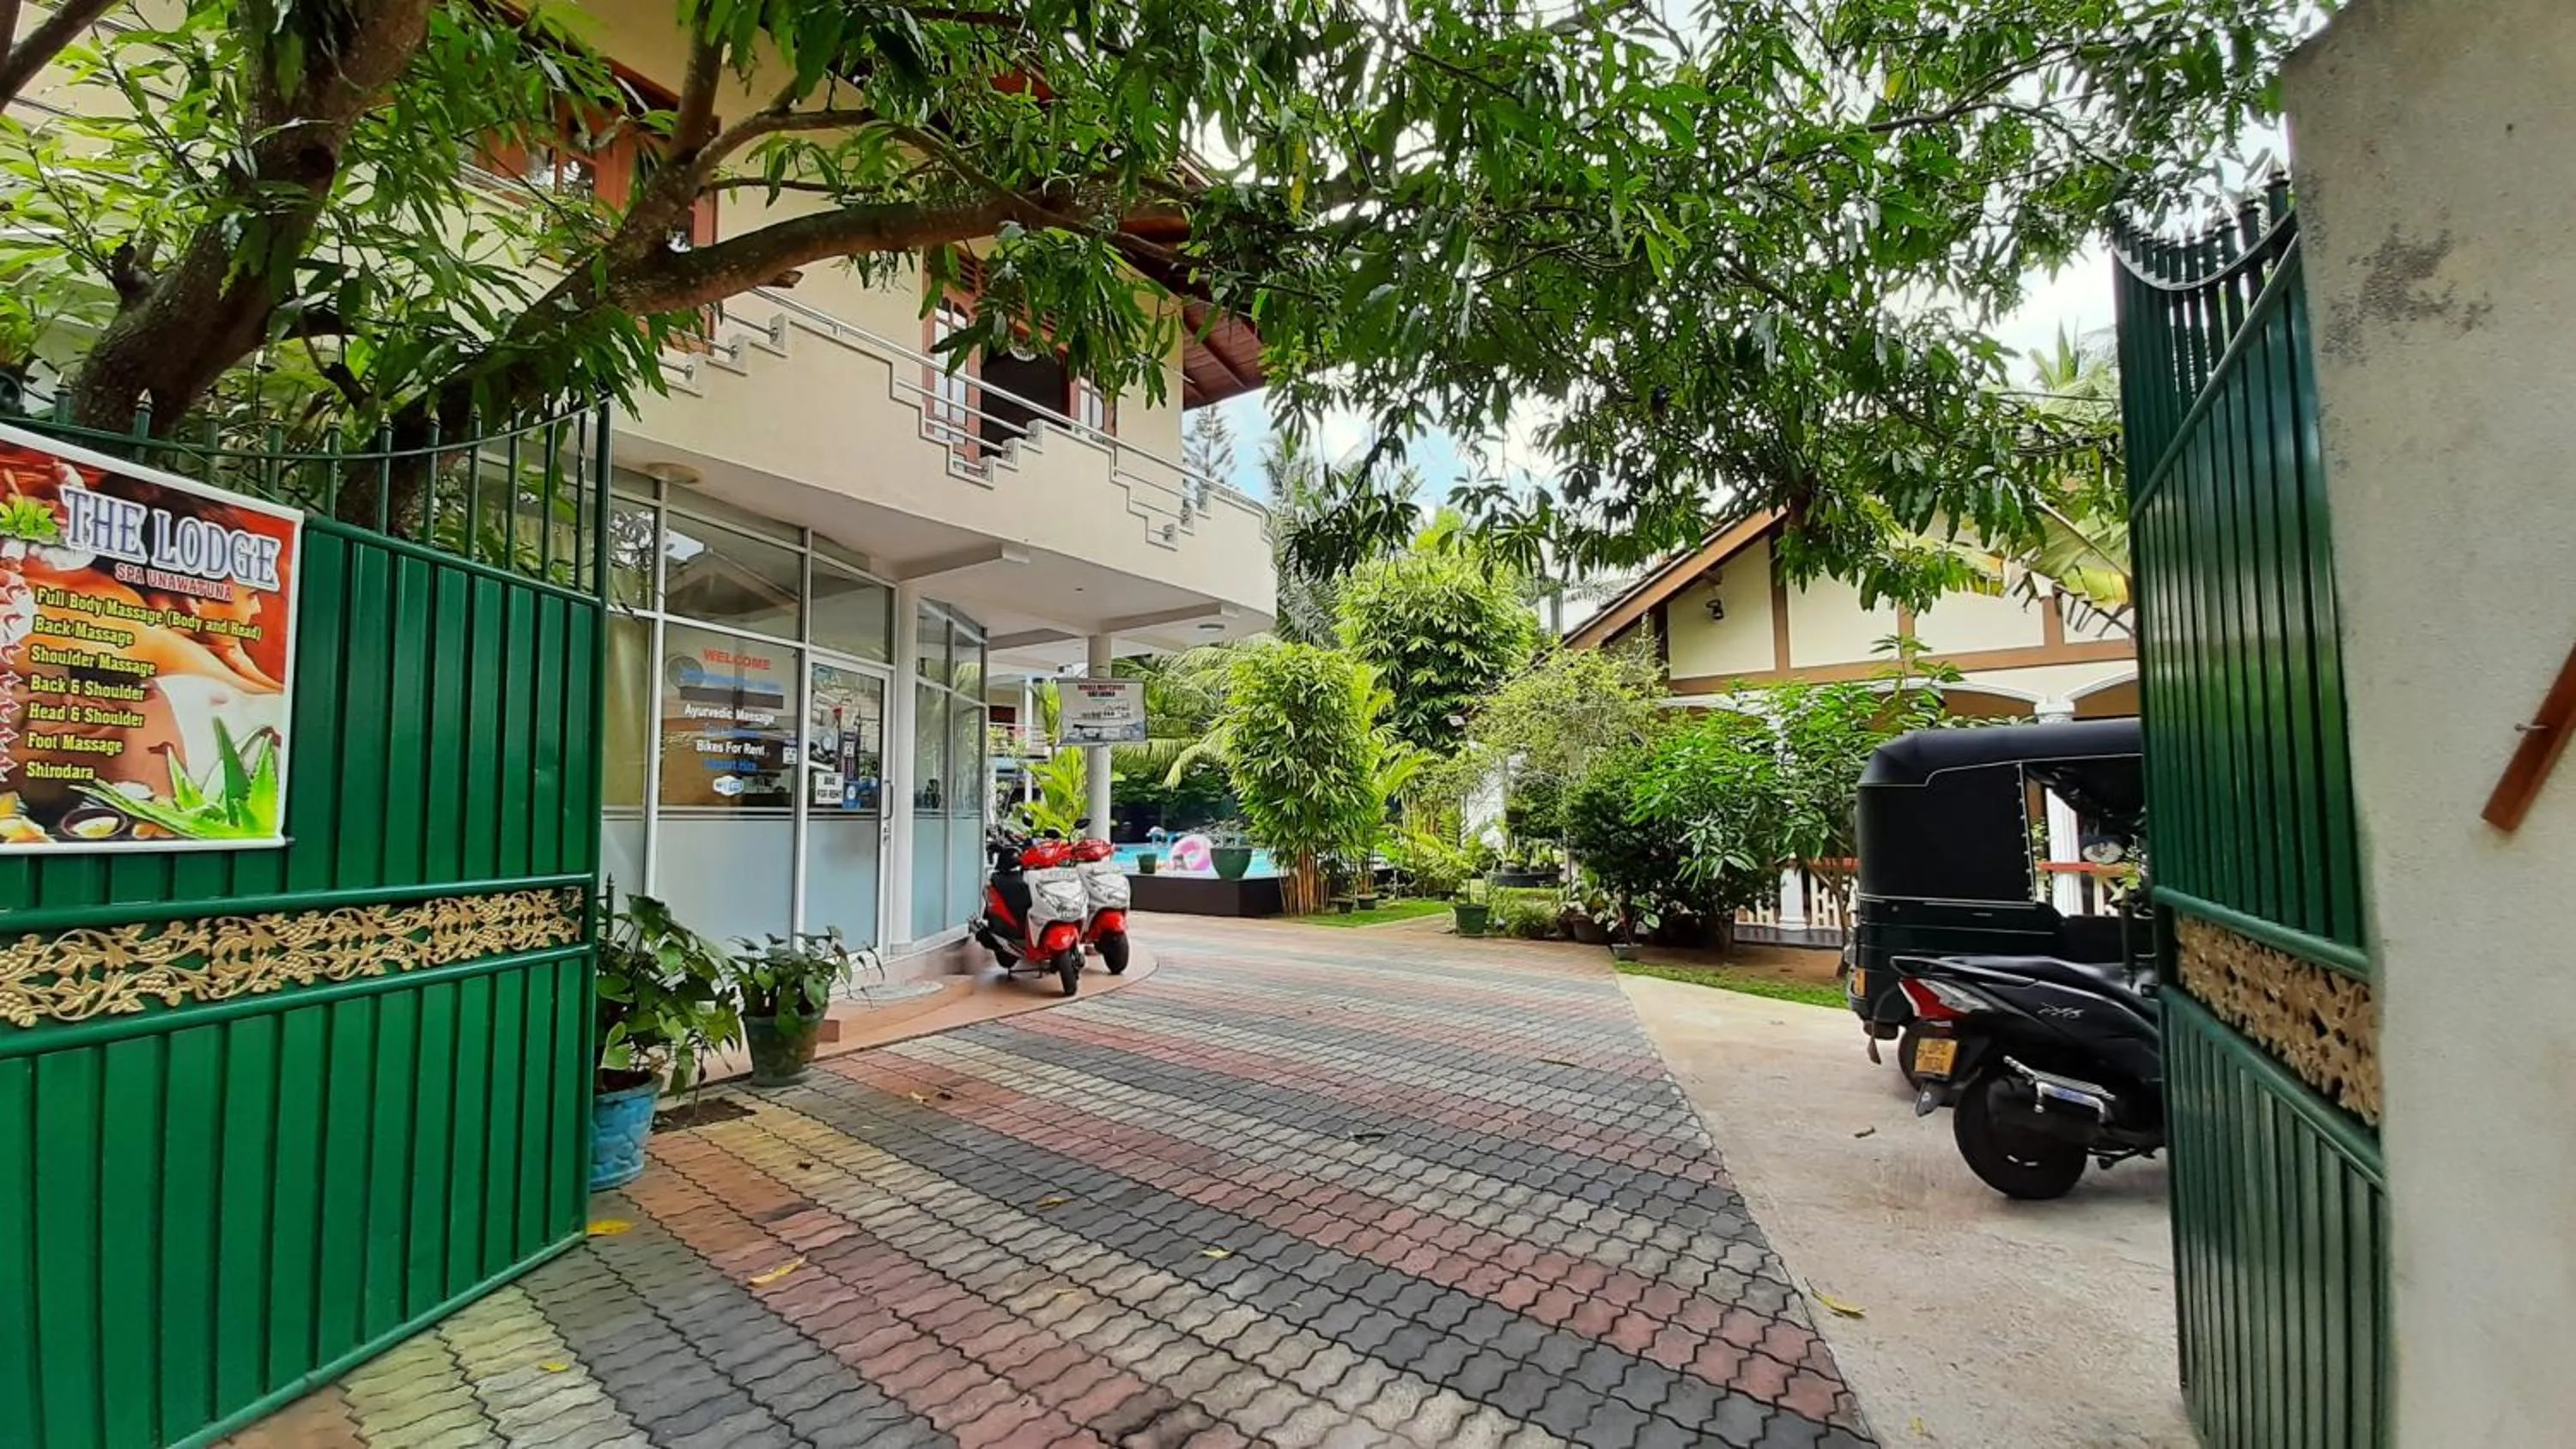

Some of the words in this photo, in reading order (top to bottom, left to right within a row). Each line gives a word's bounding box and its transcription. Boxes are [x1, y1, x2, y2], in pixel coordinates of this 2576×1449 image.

[60, 484, 148, 564] THE
[150, 508, 282, 592] LODGE
[114, 562, 145, 584] SPA
[147, 570, 234, 602] UNAWATUNA
[37, 588, 65, 606] Full
[69, 594, 102, 615] Body
[105, 600, 164, 626] Massage
[167, 611, 202, 633] (Body
[205, 618, 228, 634] and
[229, 621, 262, 641] Head)
[33, 615, 73, 634] Back
[75, 621, 135, 647] Massage
[30, 645, 95, 666] Shoulder
[98, 652, 157, 676] Massage
[703, 647, 771, 670] WELCOME
[30, 674, 67, 693] Back
[70, 679, 81, 694] &
[84, 680, 145, 700] Shoulder
[28, 701, 66, 720] Head
[70, 706, 81, 722] &
[84, 707, 144, 727] Shoulder
[684, 703, 734, 720] Ayurvedic
[27, 732, 58, 749] Foot
[61, 734, 124, 756] Massage
[696, 738, 724, 754] Bikes
[726, 741, 743, 755] For
[743, 743, 766, 757] Rent
[26, 761, 95, 779] Shirodara
